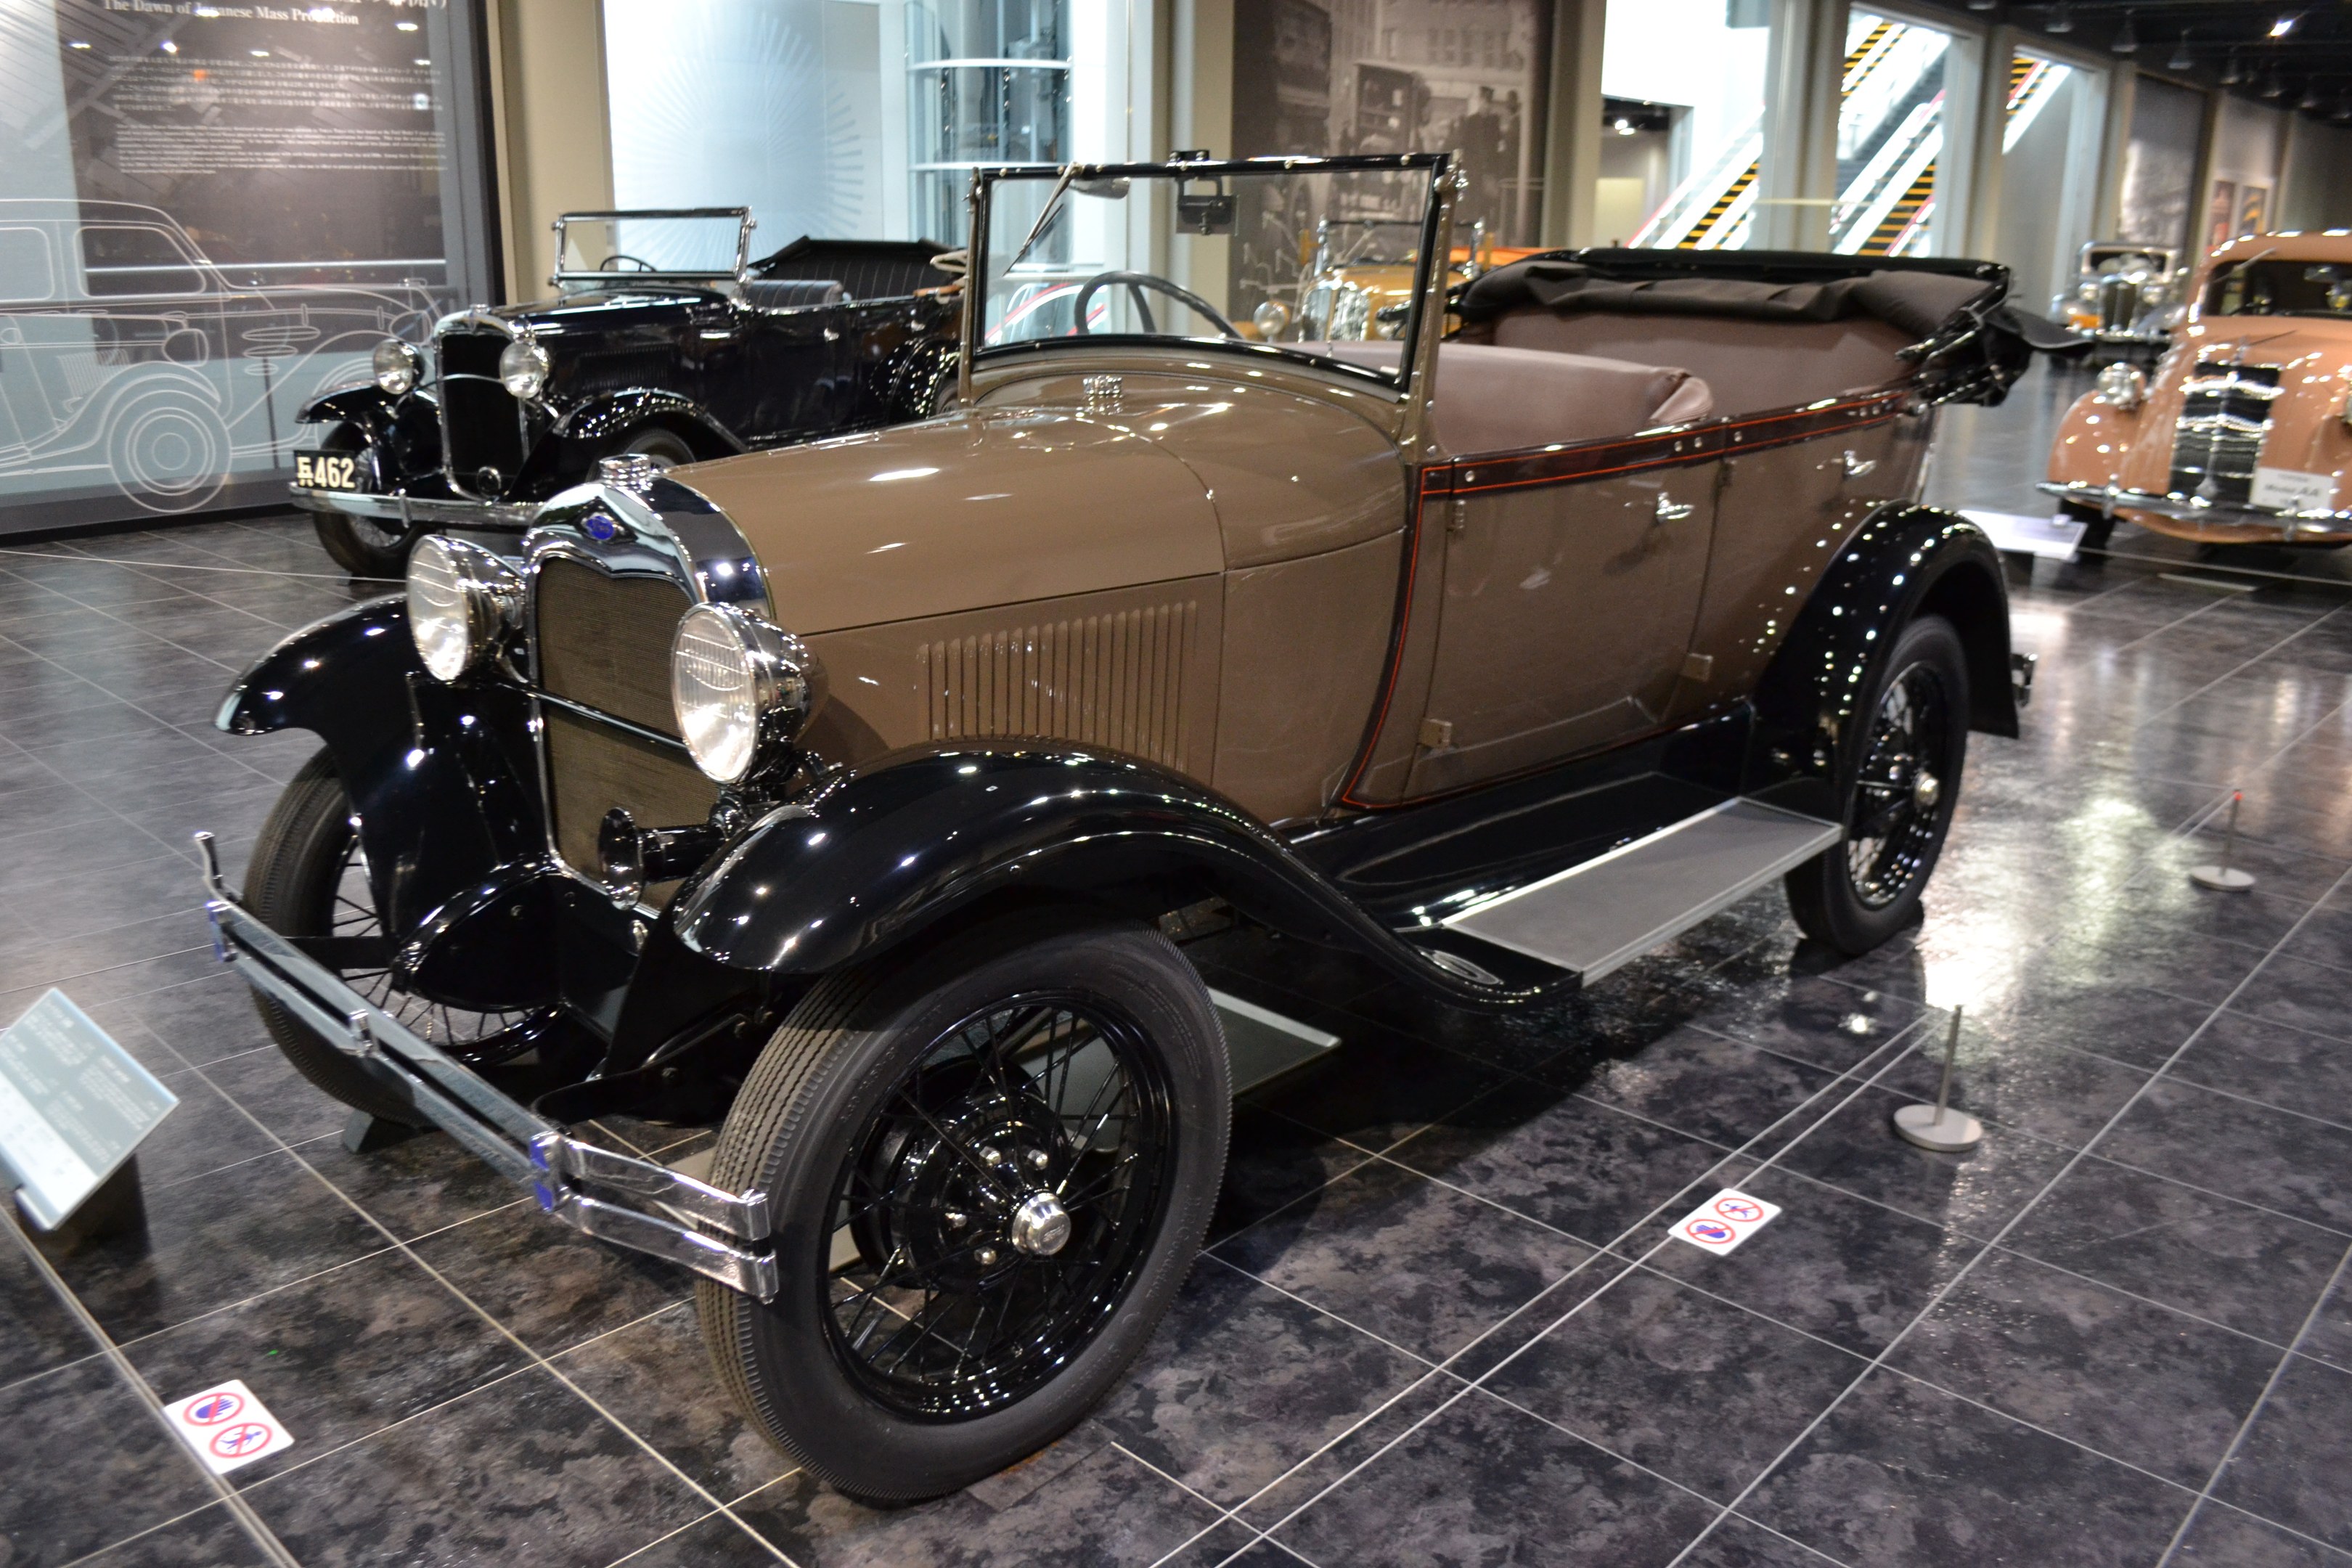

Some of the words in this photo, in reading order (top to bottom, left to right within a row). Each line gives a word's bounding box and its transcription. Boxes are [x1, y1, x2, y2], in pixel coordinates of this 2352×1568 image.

[134, 0, 173, 13] Dawn
[176, 1, 192, 15] of
[256, 6, 288, 20] Mass
